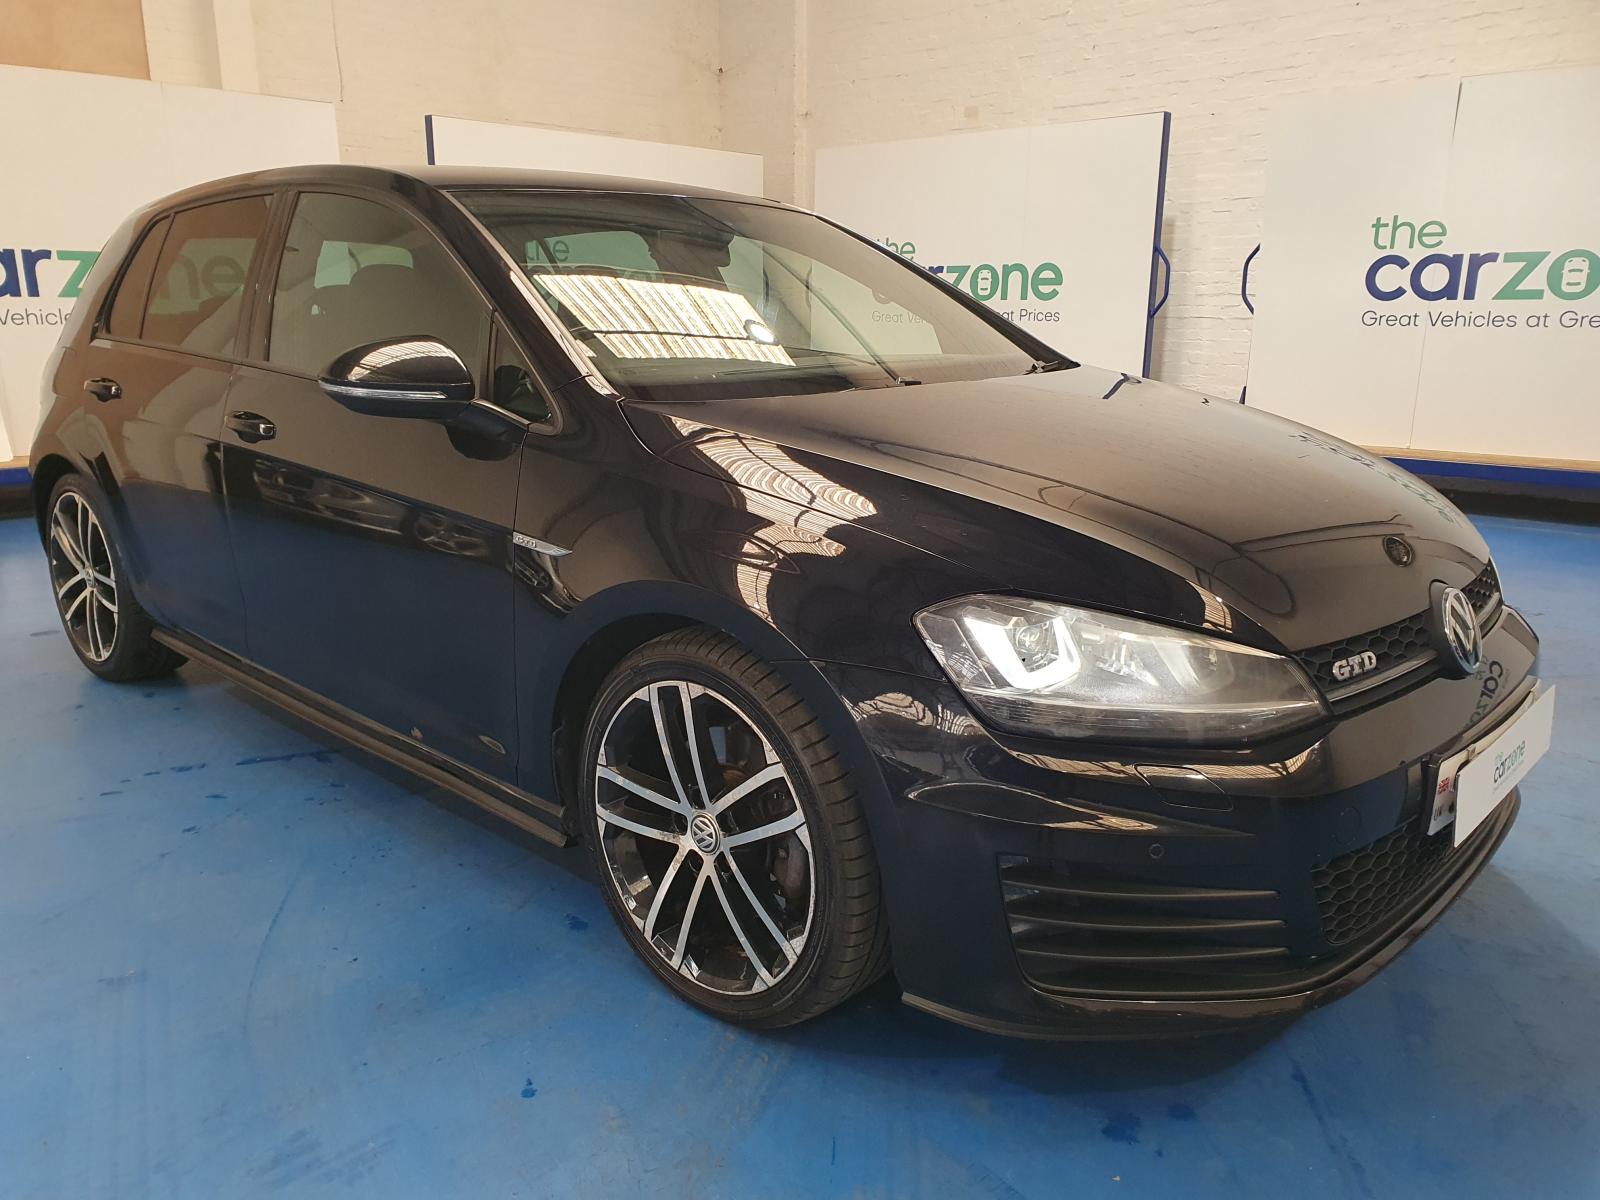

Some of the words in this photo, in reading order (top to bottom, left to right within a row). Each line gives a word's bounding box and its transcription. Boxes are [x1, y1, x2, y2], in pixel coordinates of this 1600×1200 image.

[1371, 214, 1448, 250] the
[1019, 308, 1061, 322] Prices
[1361, 310, 1420, 327] Great
[1428, 310, 1517, 328] Vehicles
[1525, 314, 1550, 328] at
[1332, 651, 1377, 681] GTD
[1493, 740, 1526, 784] carzone
